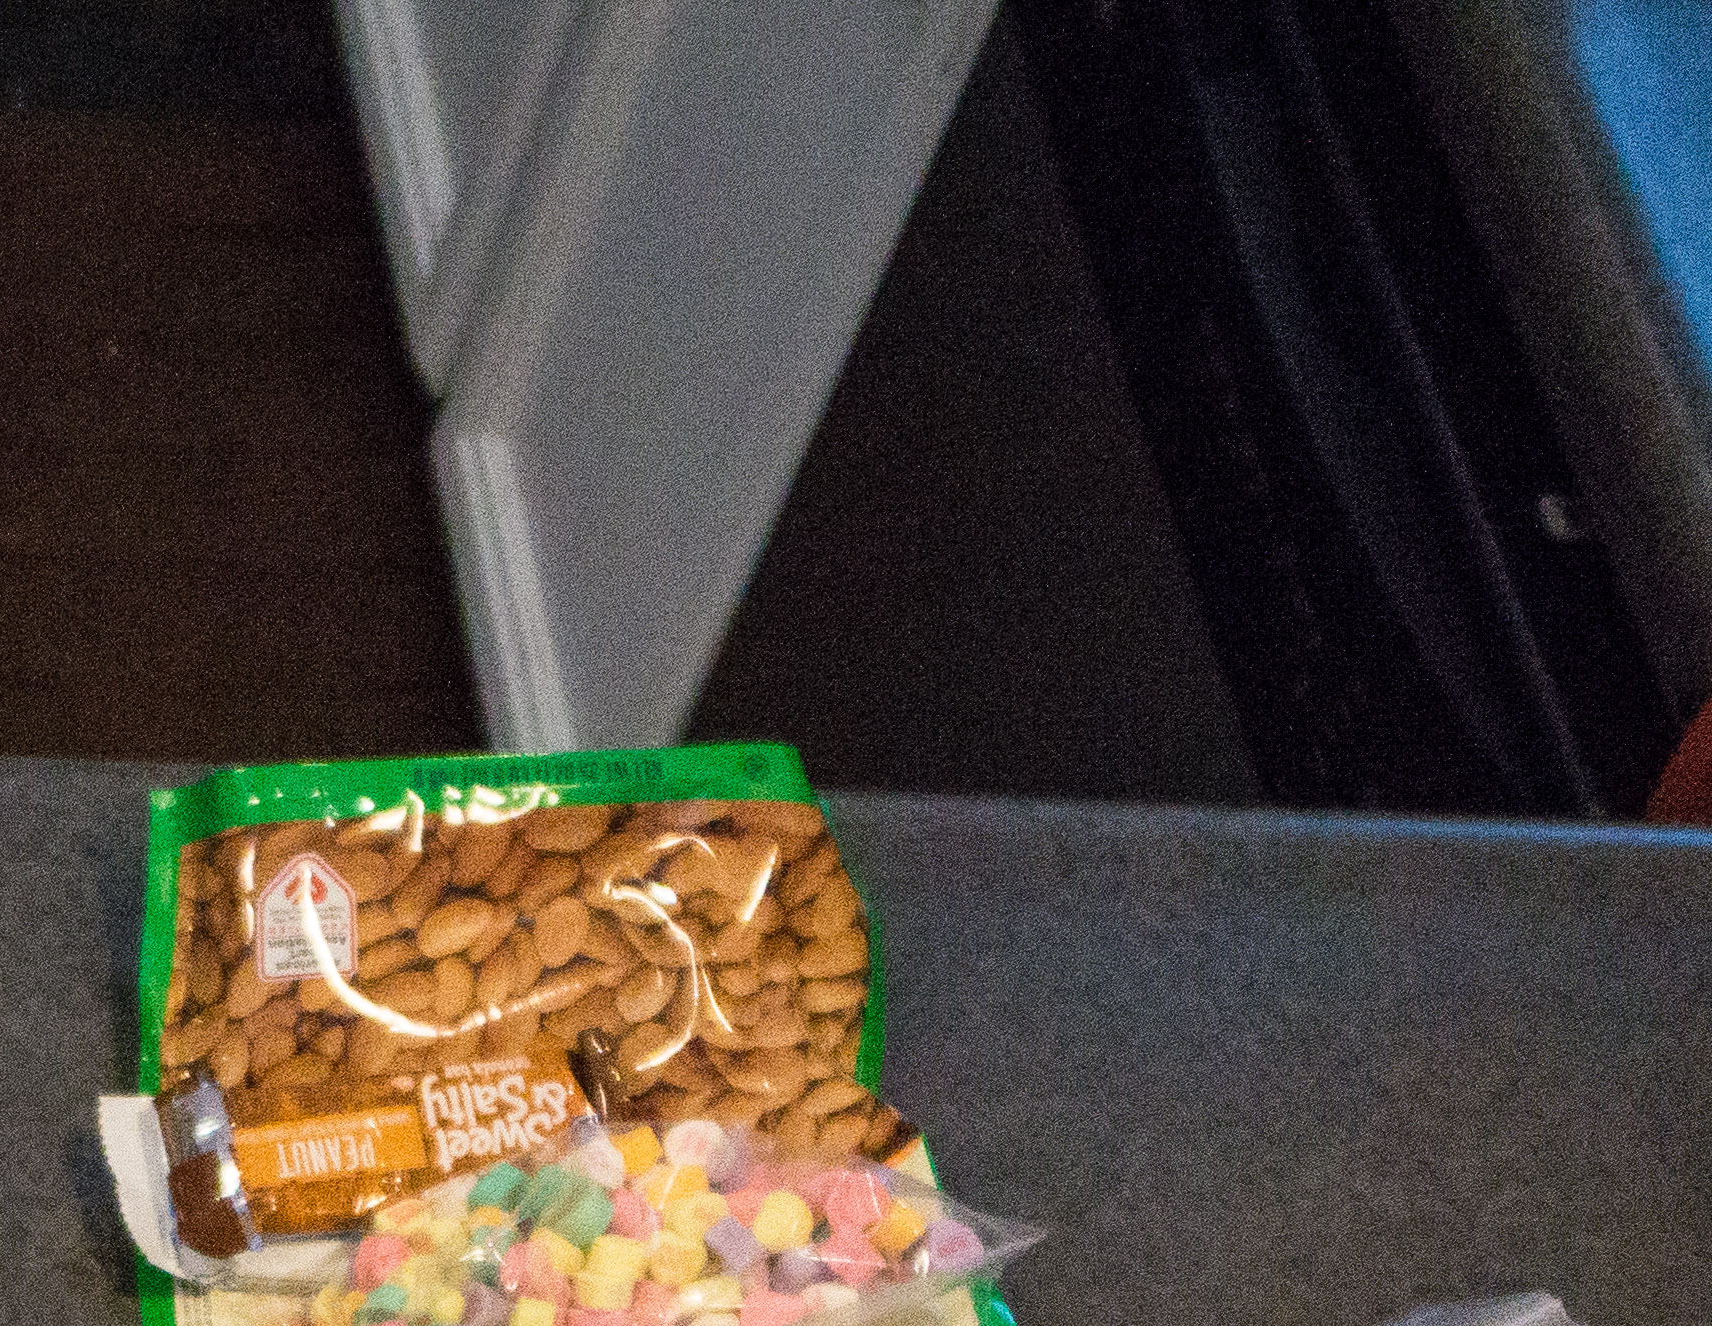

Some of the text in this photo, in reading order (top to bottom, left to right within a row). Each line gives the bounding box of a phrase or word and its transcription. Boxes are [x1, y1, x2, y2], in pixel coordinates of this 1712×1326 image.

[421, 1073, 528, 1129] Salty
[533, 1081, 568, 1126] &
[276, 1132, 376, 1179] PEANUT
